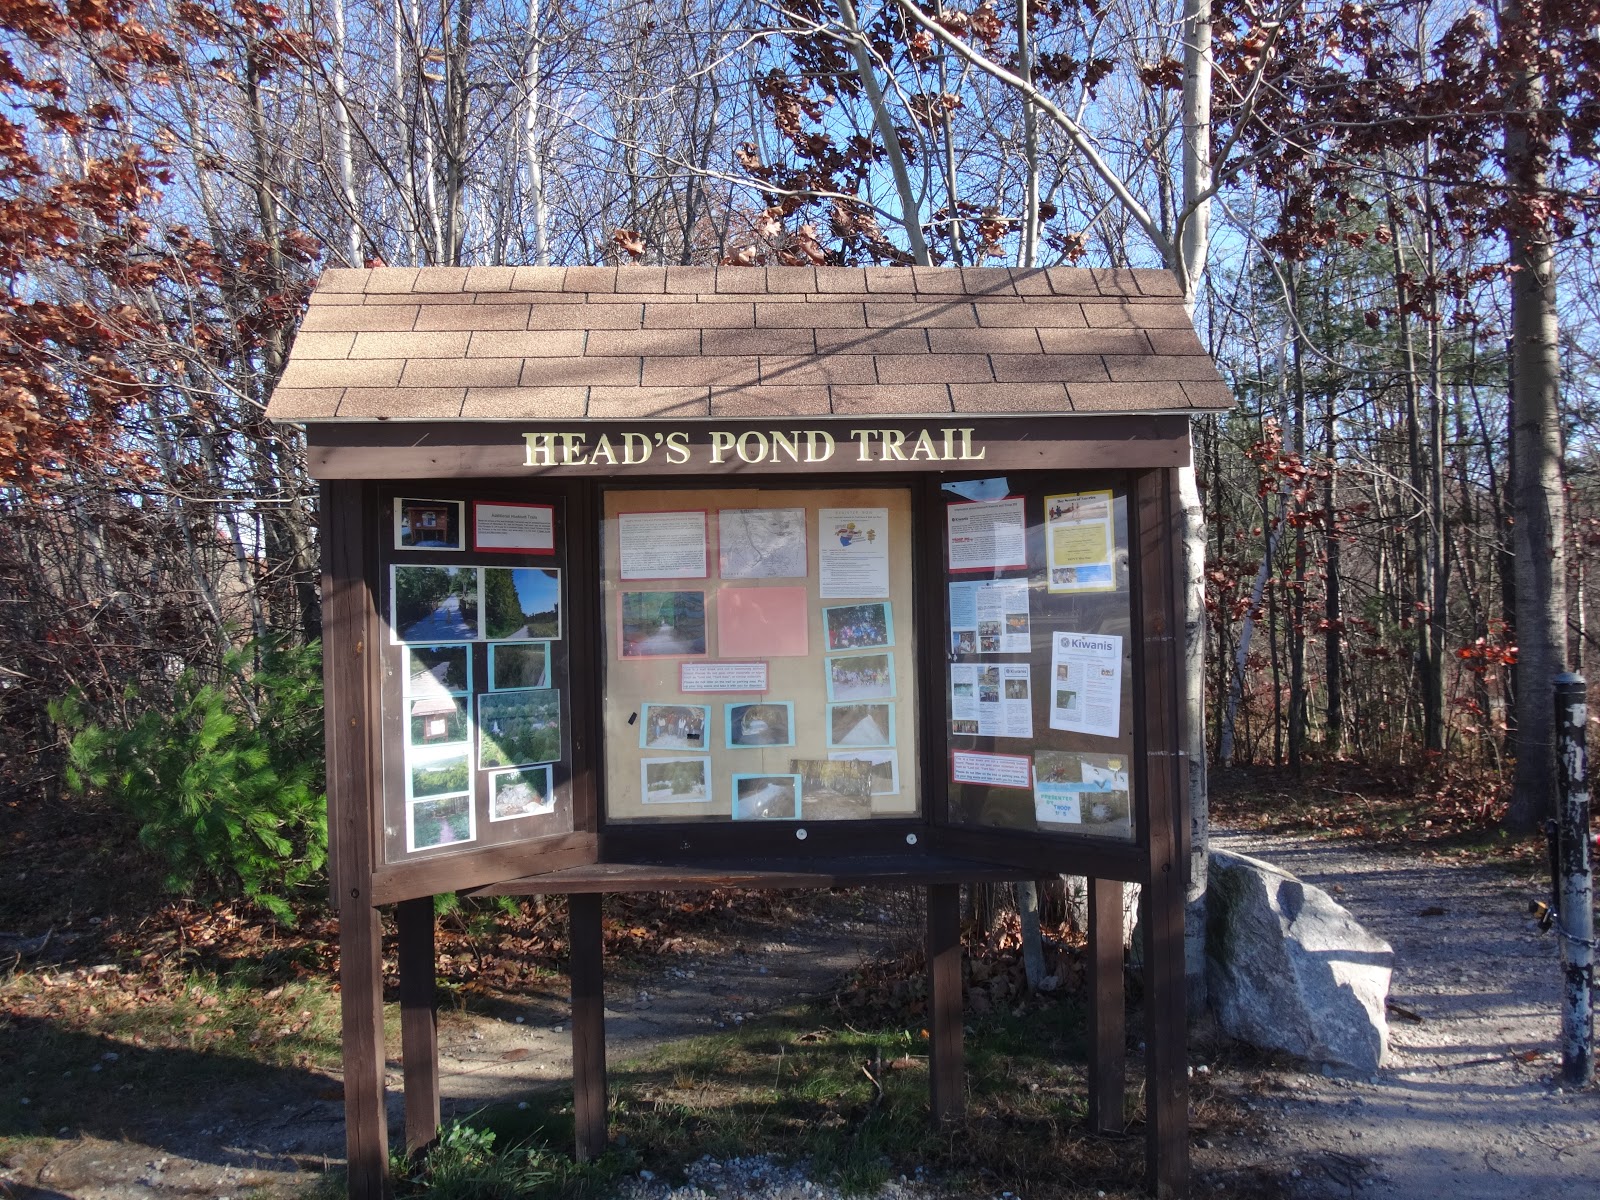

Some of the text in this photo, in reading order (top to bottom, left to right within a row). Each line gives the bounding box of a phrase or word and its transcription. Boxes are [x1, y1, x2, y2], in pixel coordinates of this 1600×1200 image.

[522, 428, 986, 466] HEAD'S POND TRAIL
[1072, 639, 1112, 650] Kiwanis
